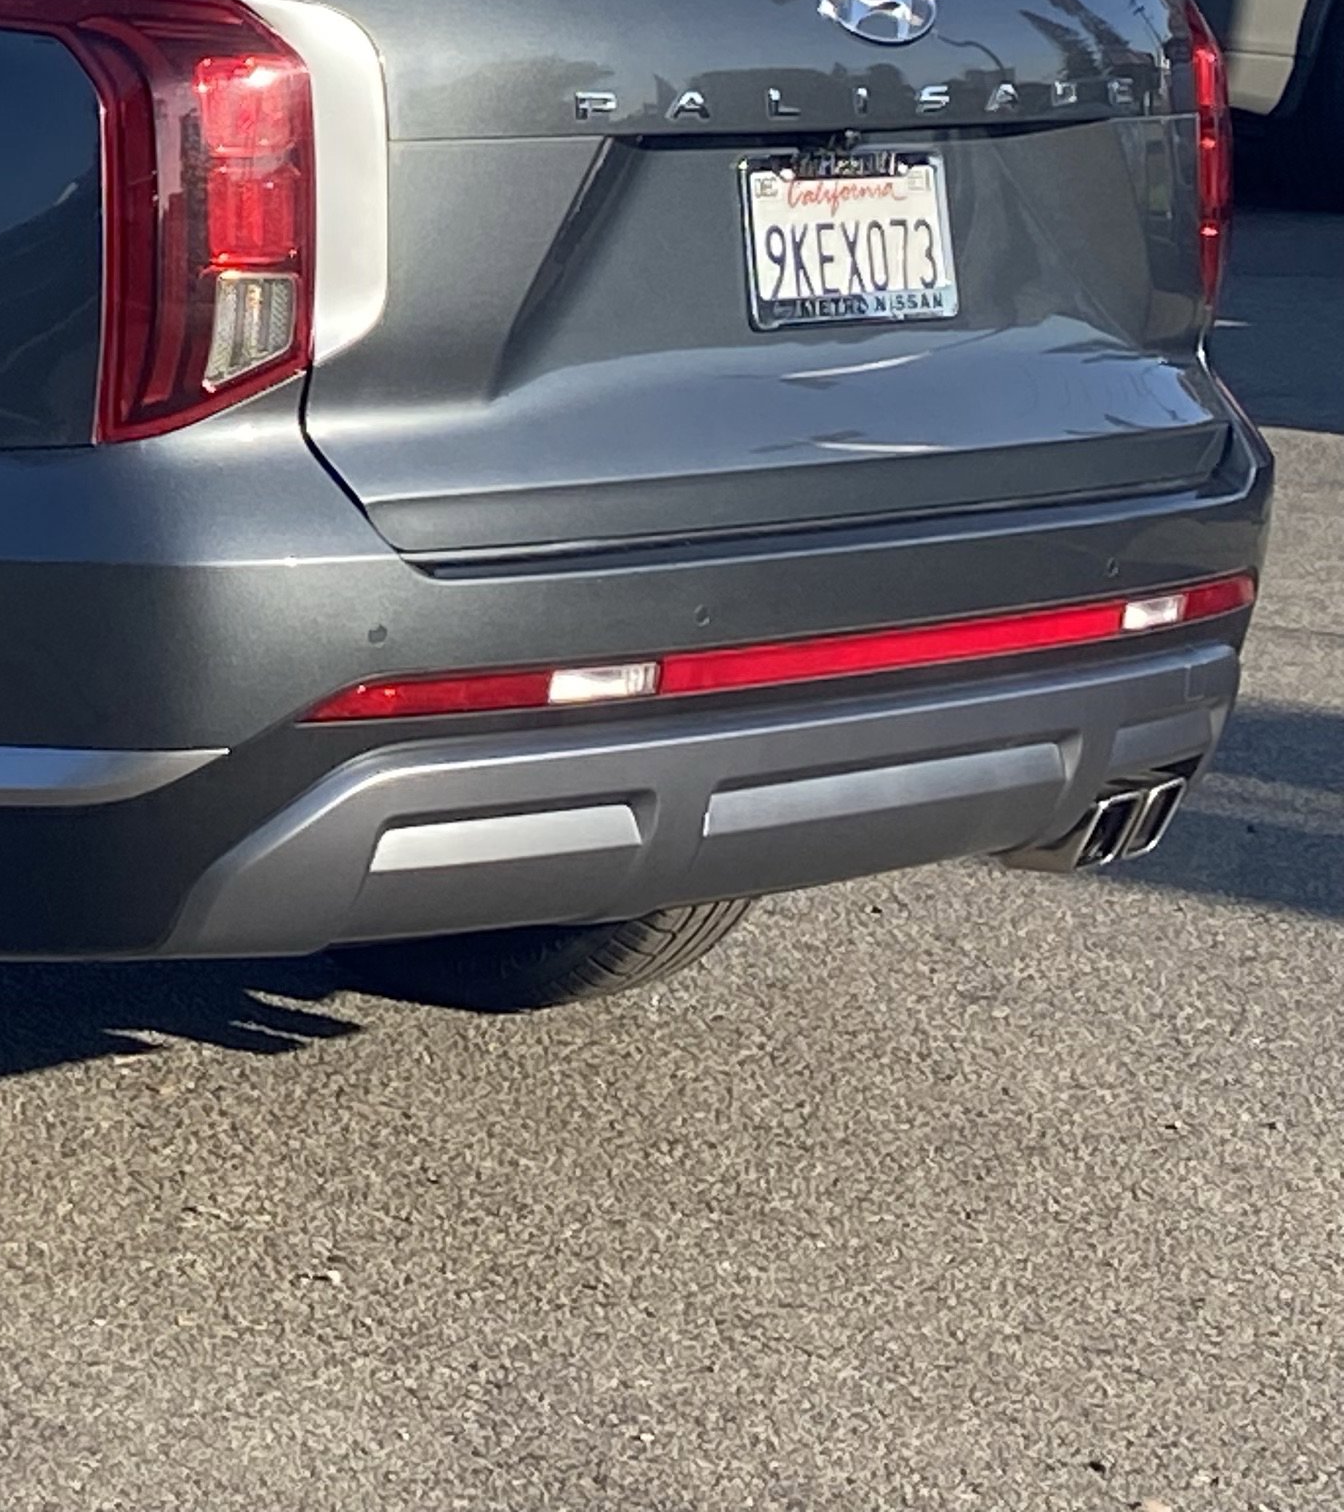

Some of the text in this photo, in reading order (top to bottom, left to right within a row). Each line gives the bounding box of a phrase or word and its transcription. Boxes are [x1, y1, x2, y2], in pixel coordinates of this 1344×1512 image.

[574, 76, 1138, 121] PALISADE
[785, 179, 908, 217] California
[765, 218, 938, 301] 9KEX073
[799, 291, 944, 318] METRO NISSAN
